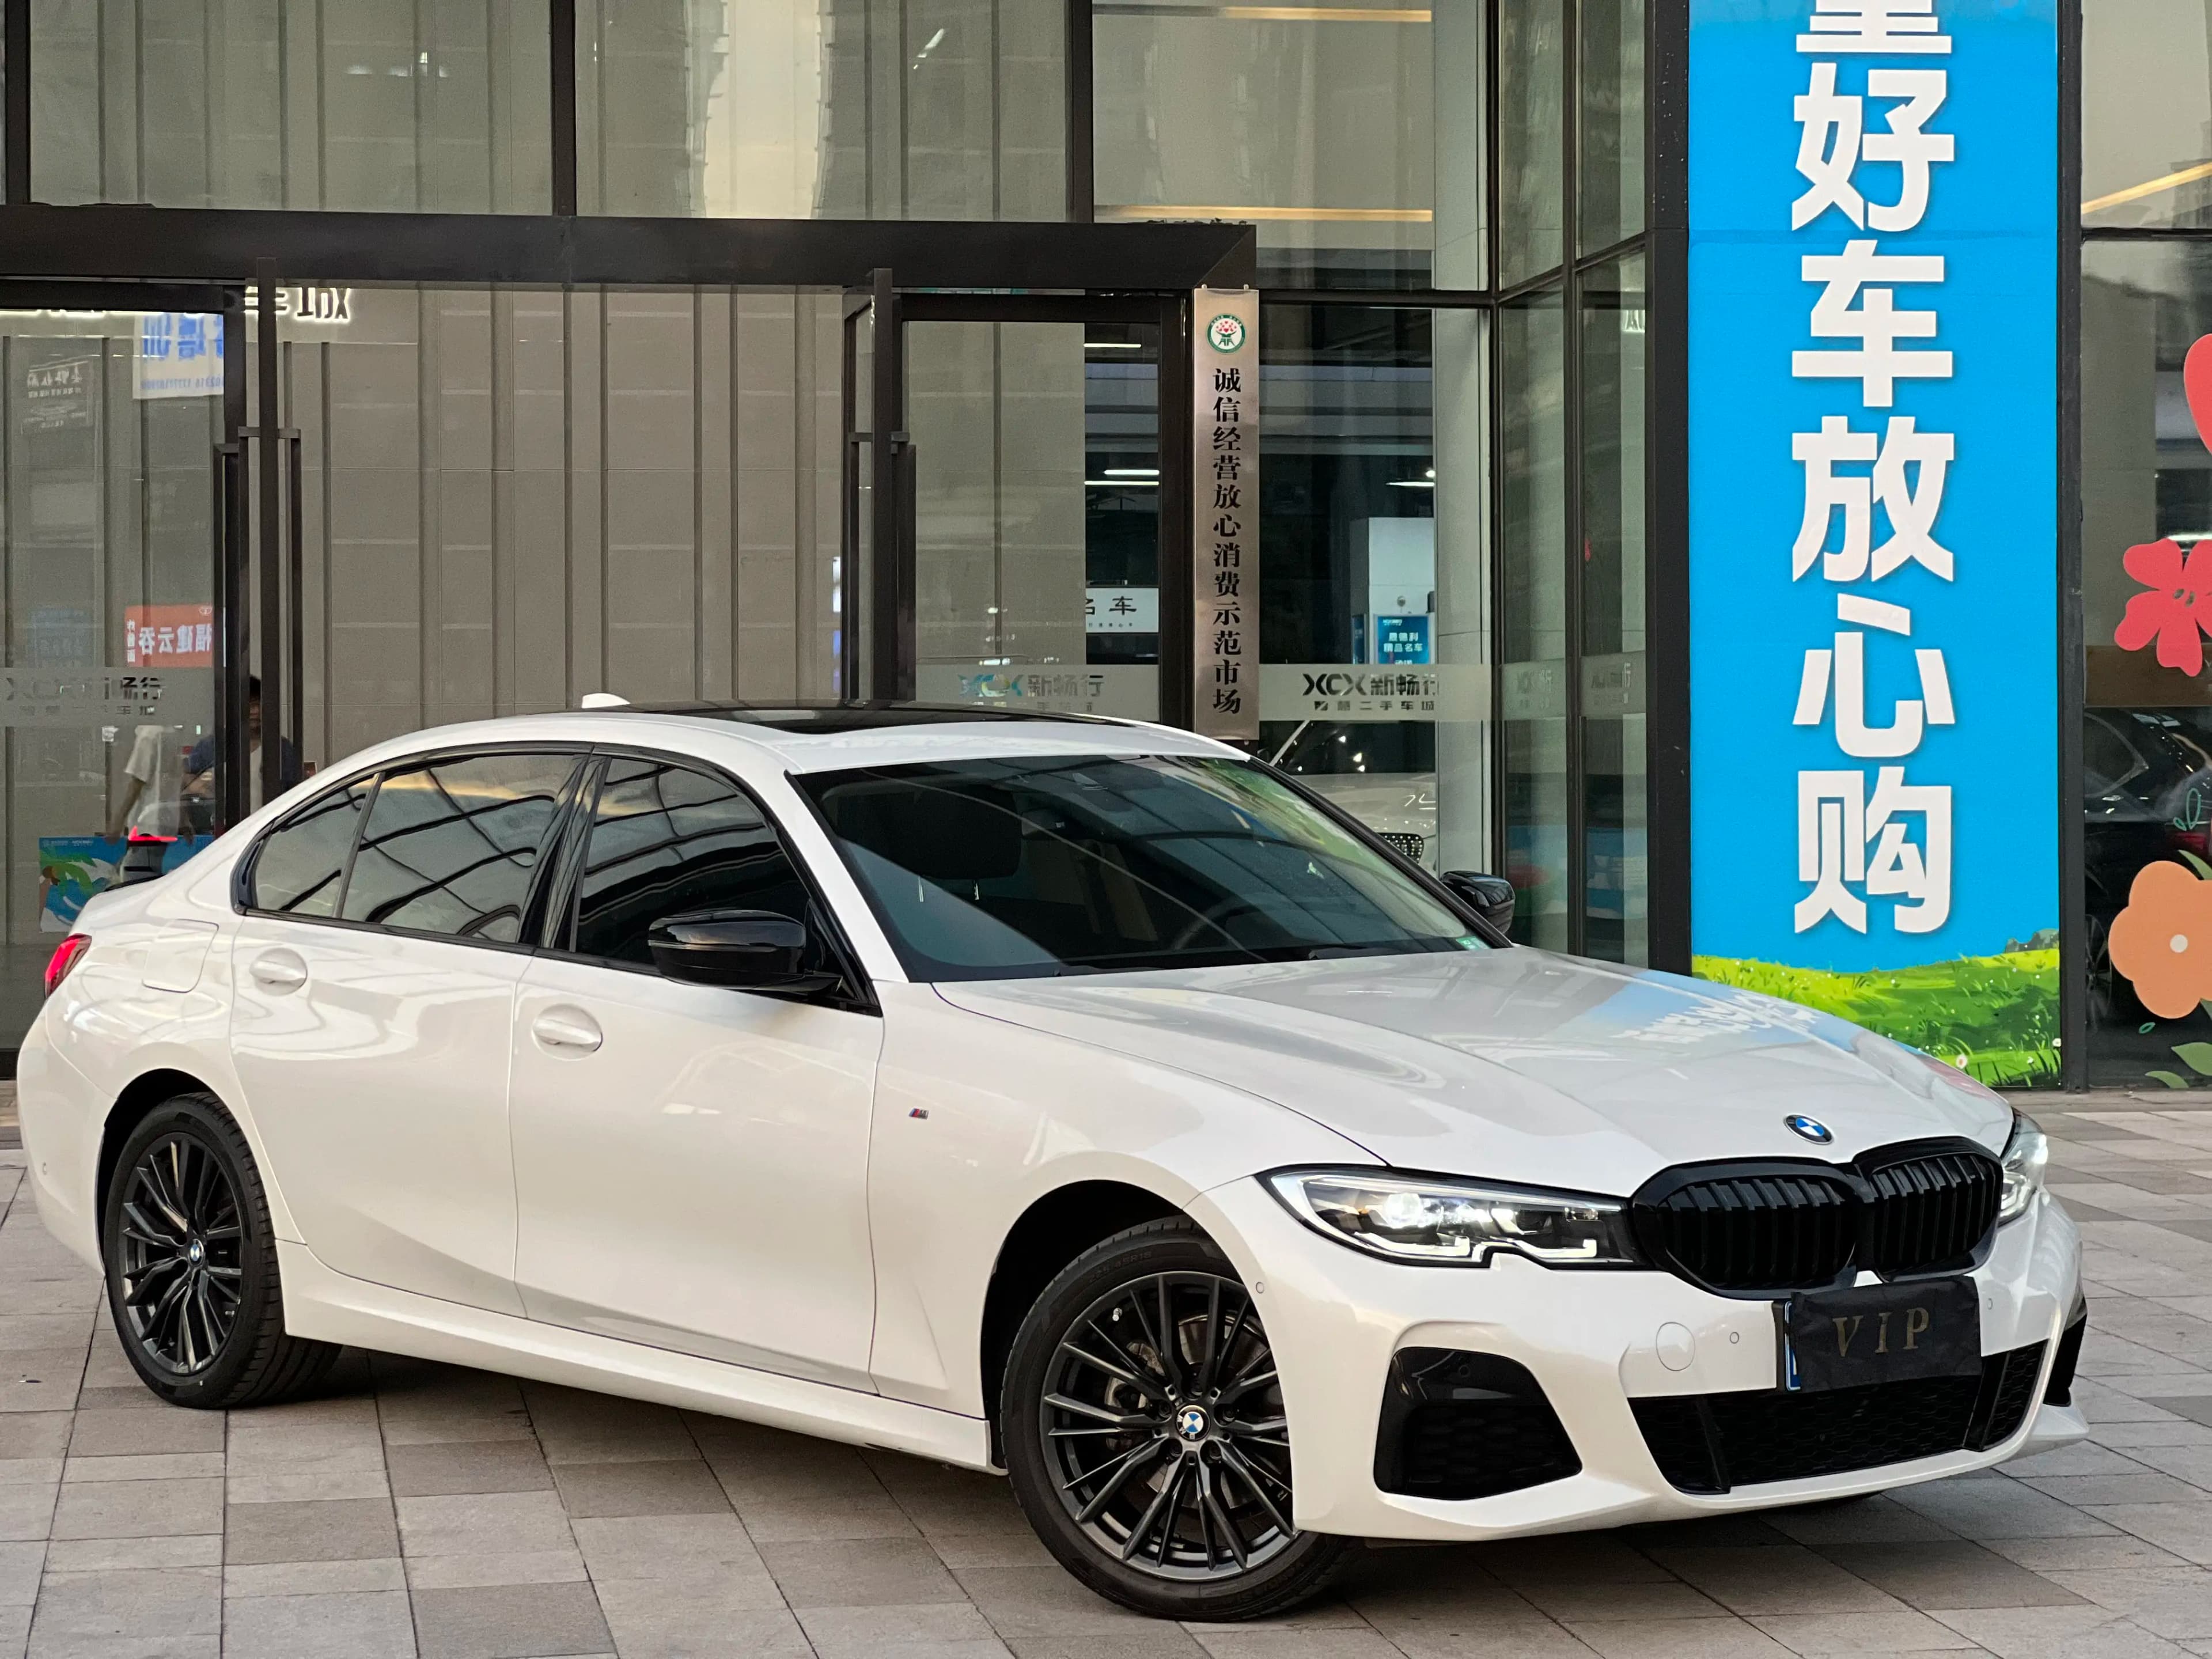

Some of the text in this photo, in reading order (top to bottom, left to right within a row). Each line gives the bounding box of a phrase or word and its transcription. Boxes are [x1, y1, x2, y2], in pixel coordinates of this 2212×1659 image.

[1213, 368, 1241, 714] 诚信经营放心消费示范市场
[1832, 1306, 1930, 1357] VIP
